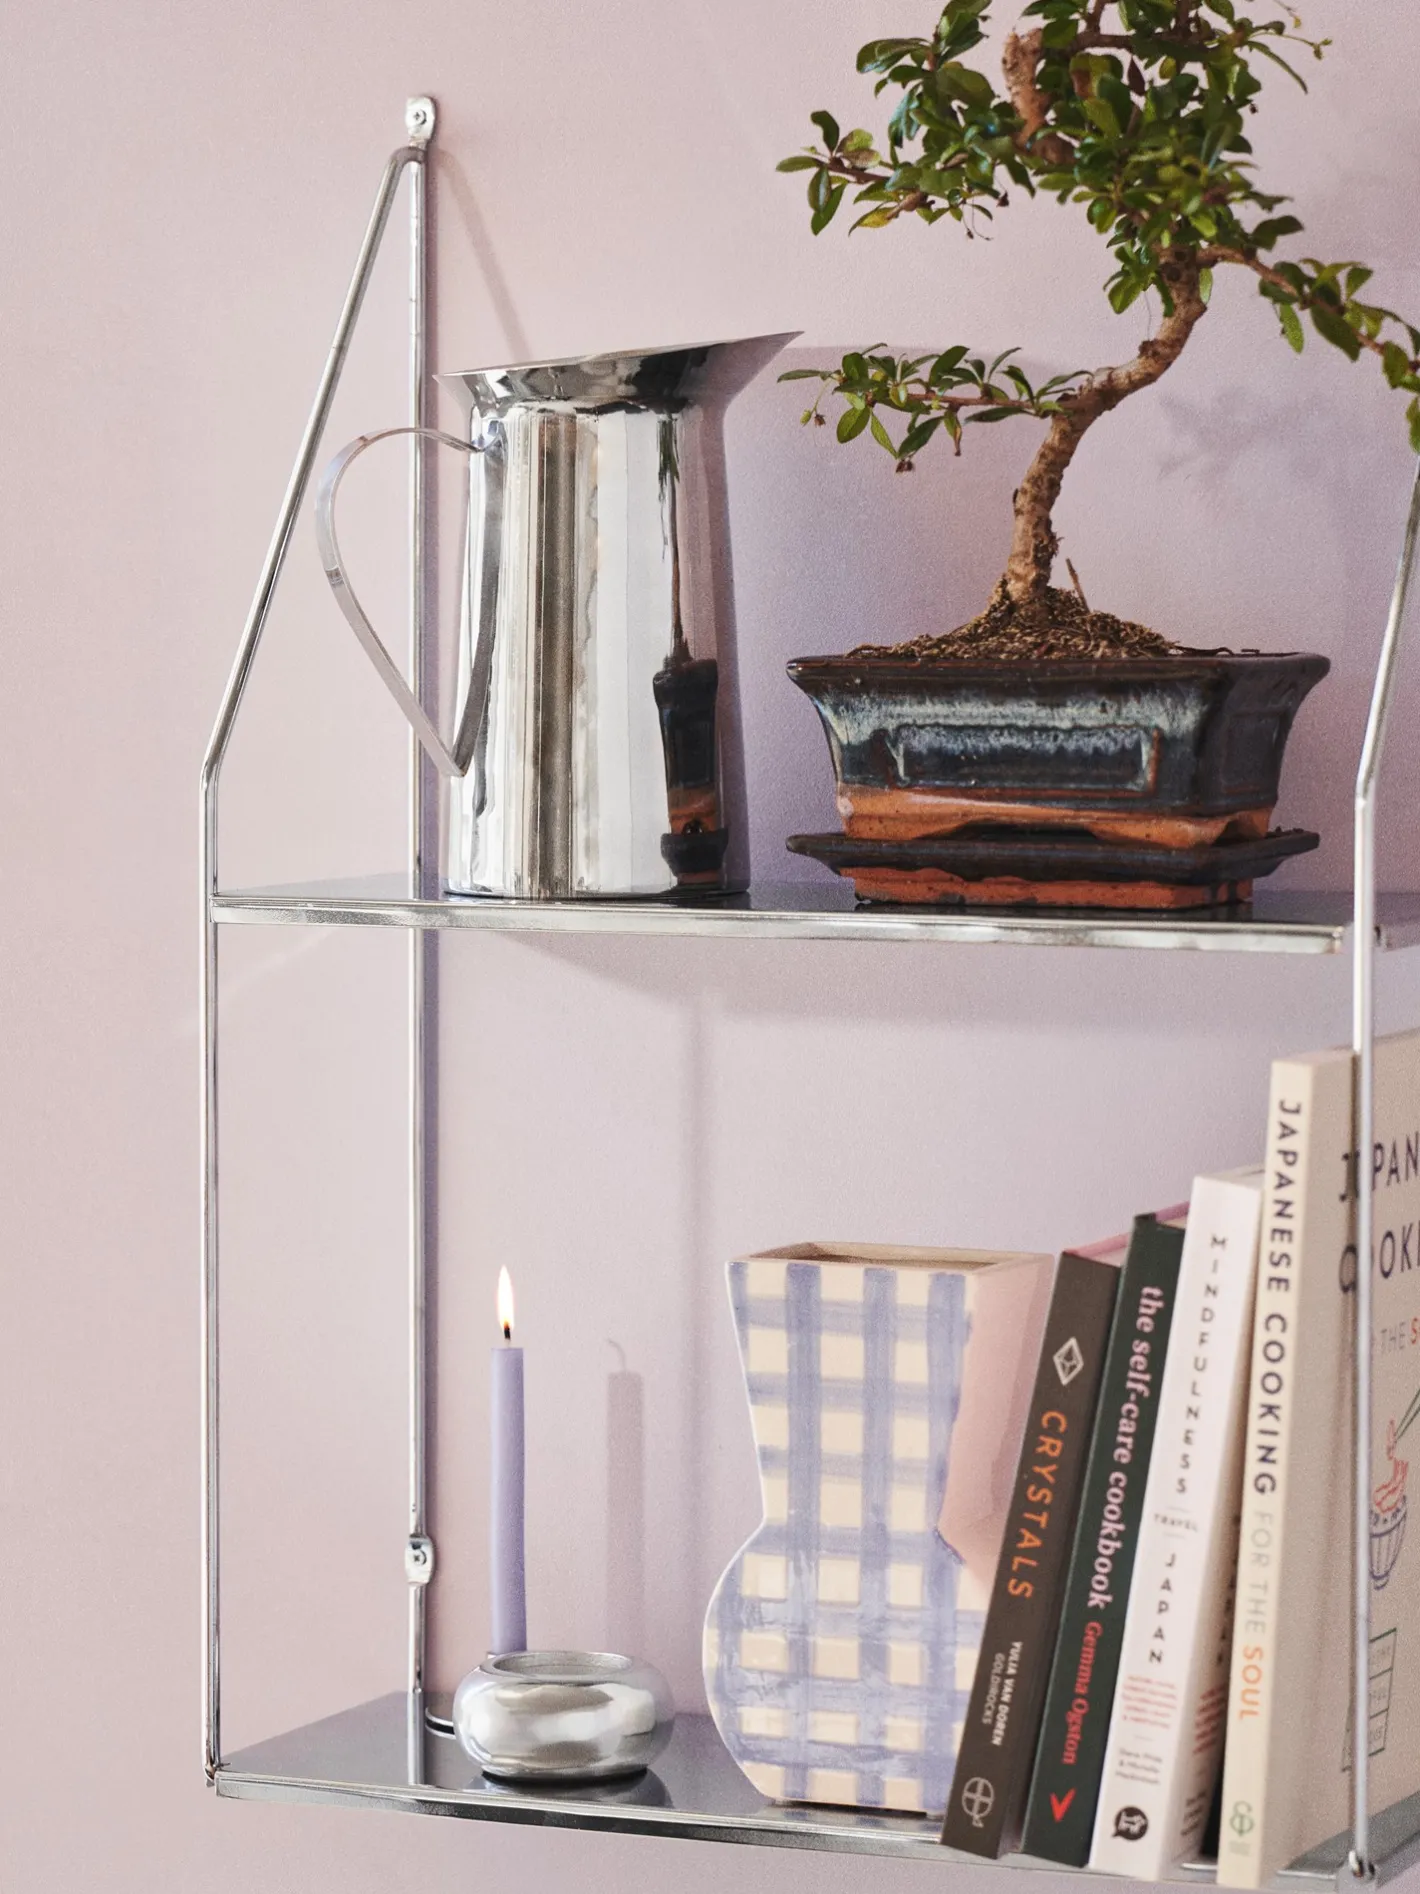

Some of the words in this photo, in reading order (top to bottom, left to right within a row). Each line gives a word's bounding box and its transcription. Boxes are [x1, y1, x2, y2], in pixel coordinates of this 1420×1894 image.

[1266, 1098, 1302, 1293] JAPANESE
[1135, 1285, 1165, 1333] the
[1112, 1340, 1153, 1464] self-care
[1175, 1235, 1228, 1495] MINDFULNESS
[1253, 1313, 1287, 1496] COOKING
[1007, 1410, 1068, 1599] CRYSTALS
[1085, 1472, 1130, 1611] cookbook
[1250, 1510, 1274, 1569] FOR
[1147, 1553, 1178, 1665] JAPAN
[1244, 1583, 1270, 1636] THE
[1000, 1678, 1016, 1703] VAN
[1006, 1641, 1024, 1675] YULIA
[1074, 1620, 1104, 1694] Gemma
[1239, 1646, 1264, 1721] SOUL
[992, 1704, 1011, 1746] DOREN
[1061, 1696, 1090, 1766] Ogston
